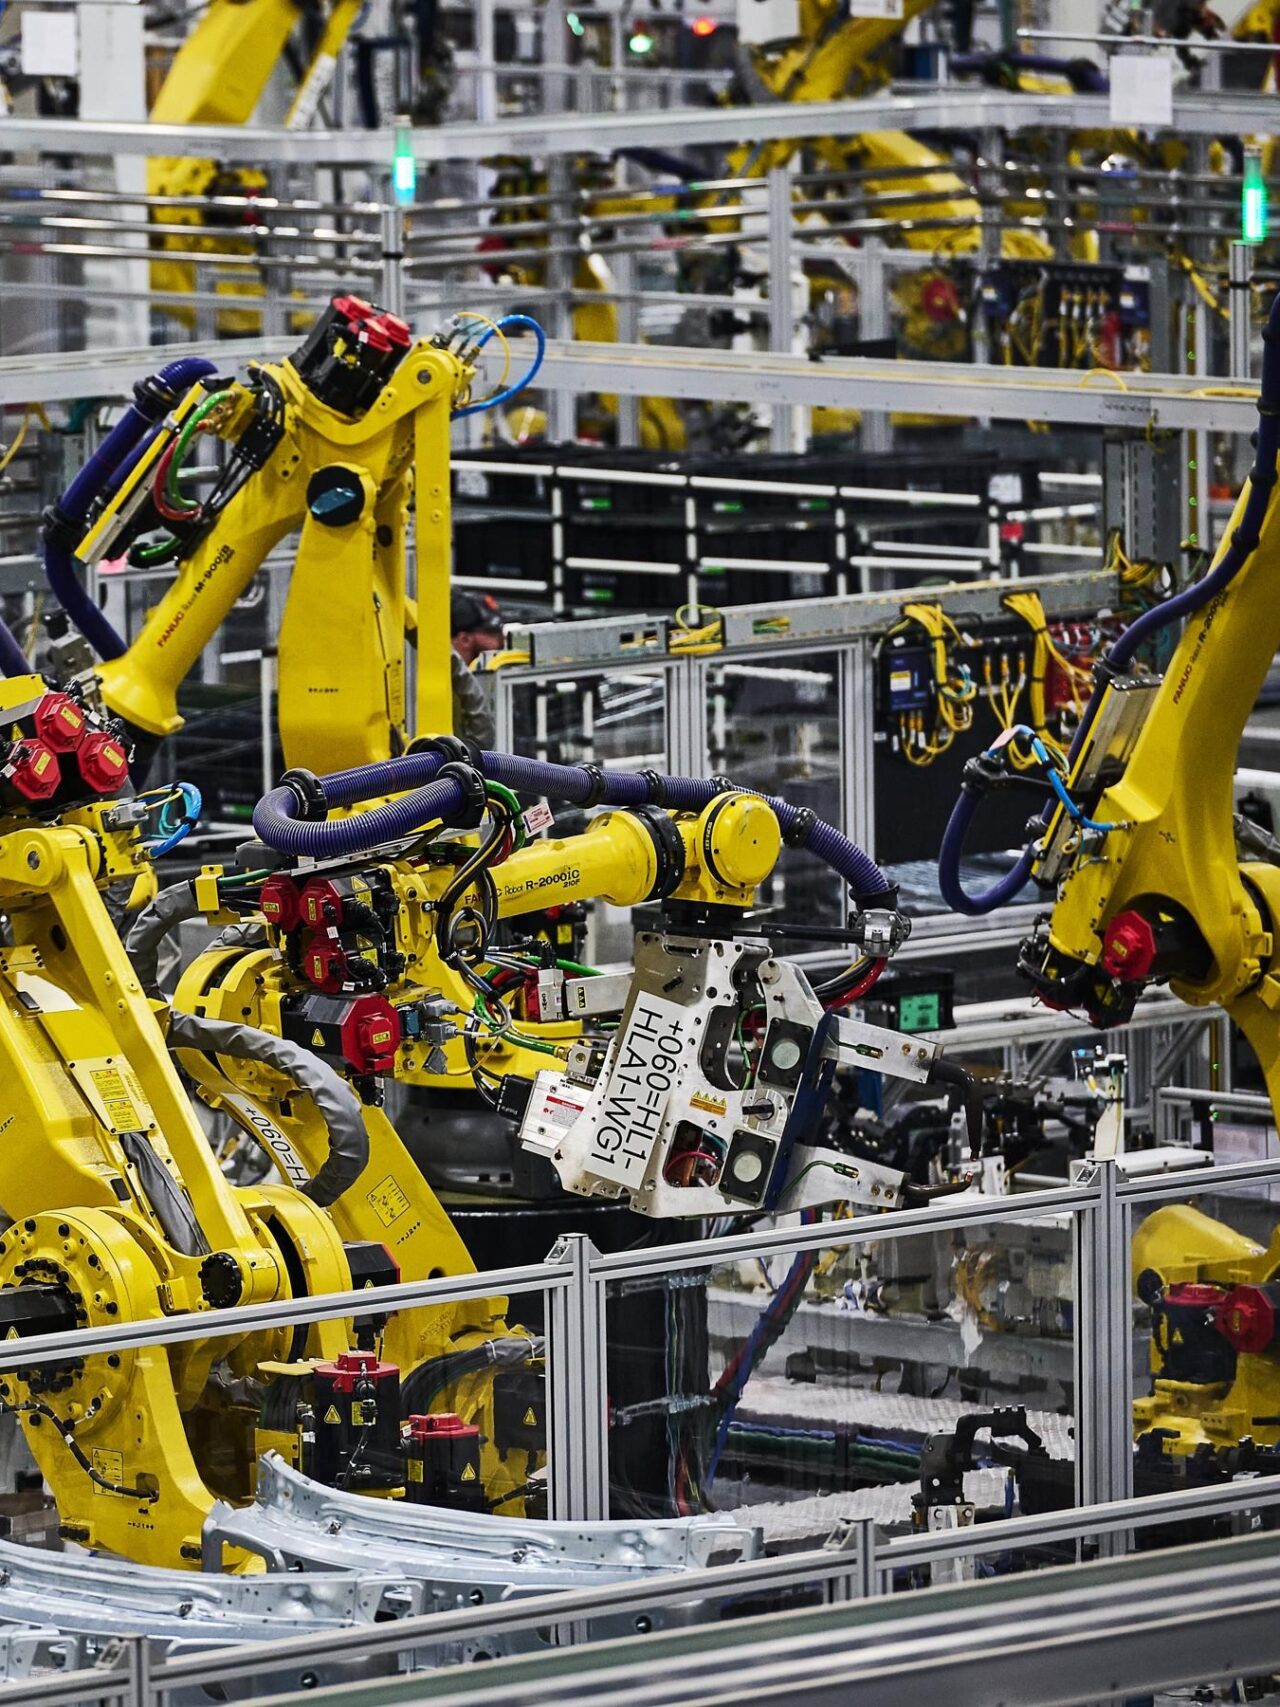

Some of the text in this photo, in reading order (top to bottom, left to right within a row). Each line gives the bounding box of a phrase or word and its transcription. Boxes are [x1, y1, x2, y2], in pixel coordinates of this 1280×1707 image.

[157, 611, 184, 648] FANUC
[1172, 663, 1193, 705] FANUC
[504, 884, 523, 896] Robot
[525, 866, 581, 891] R-2000iC
[591, 1007, 663, 1165] HLA1-WG1
[622, 1020, 683, 1170] +060=HL1-
